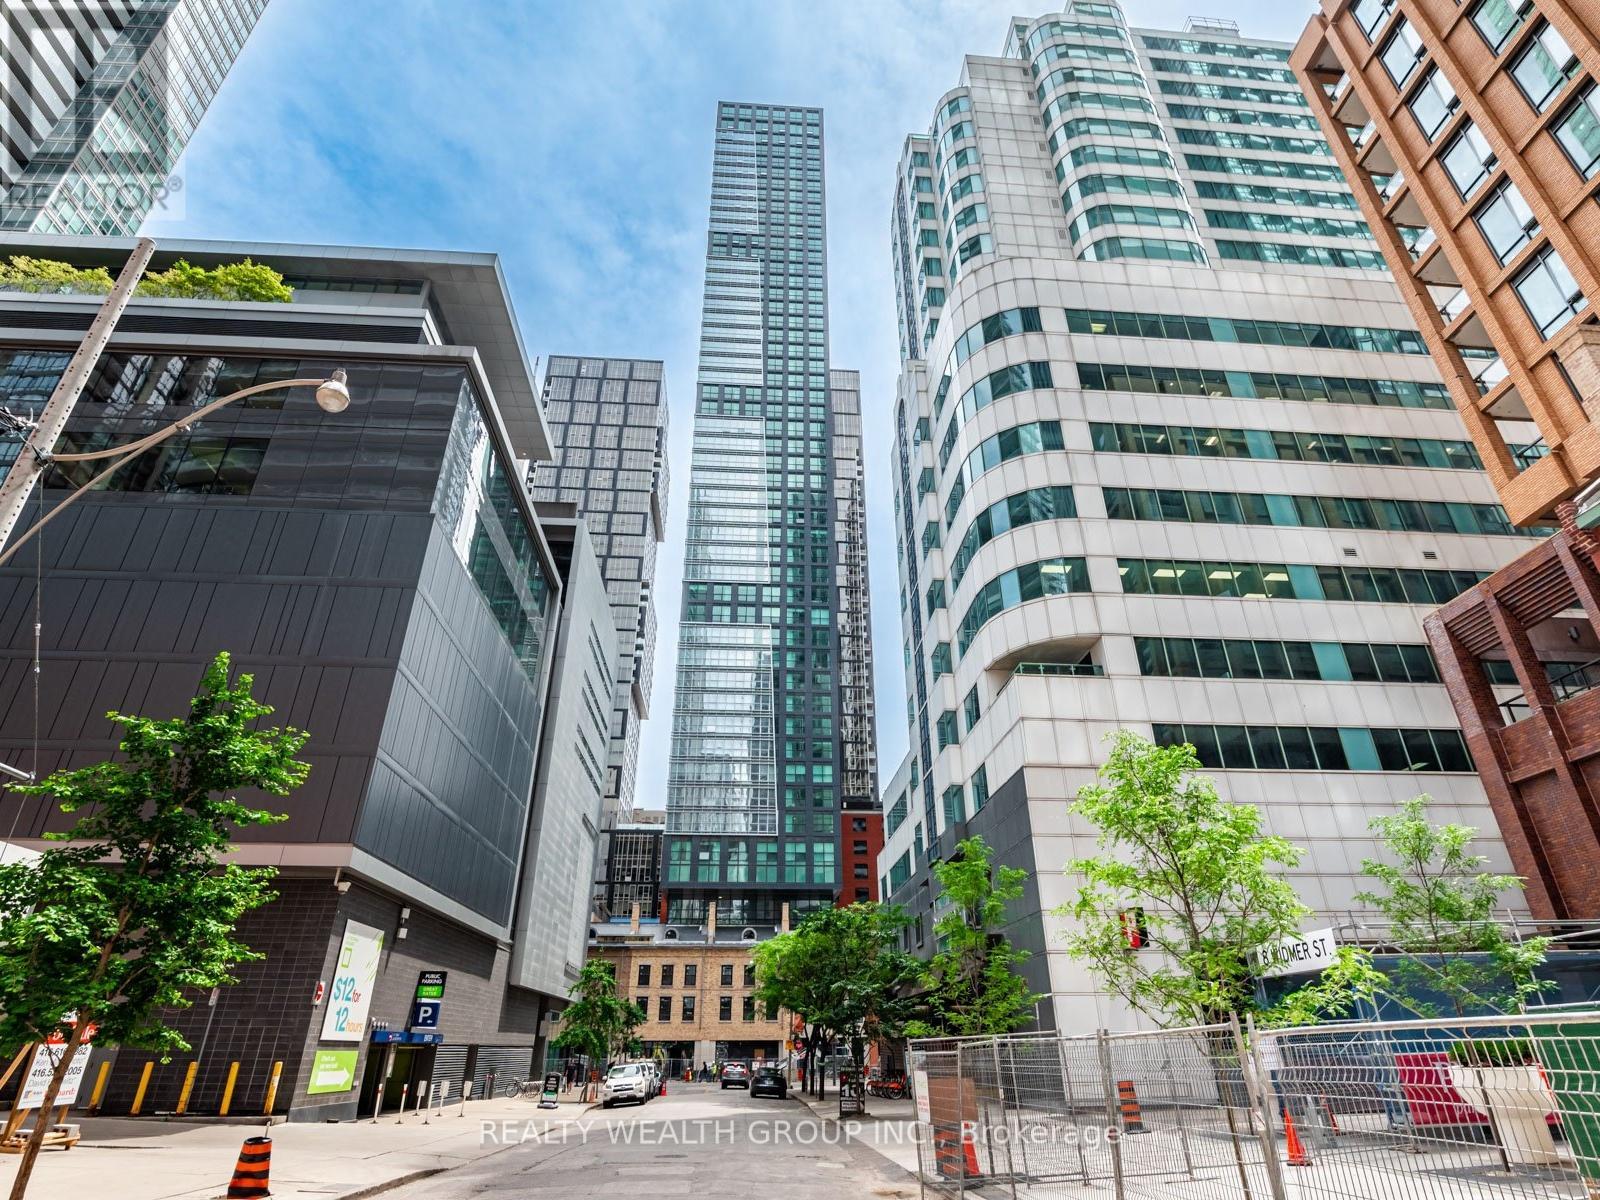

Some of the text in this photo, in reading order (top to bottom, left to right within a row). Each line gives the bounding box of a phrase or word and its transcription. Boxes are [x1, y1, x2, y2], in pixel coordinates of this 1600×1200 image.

[1312, 938, 1332, 958] ST.
[333, 976, 362, 1003] $12 for
[335, 1007, 364, 1033] 12 hours
[418, 1006, 433, 1023] P
